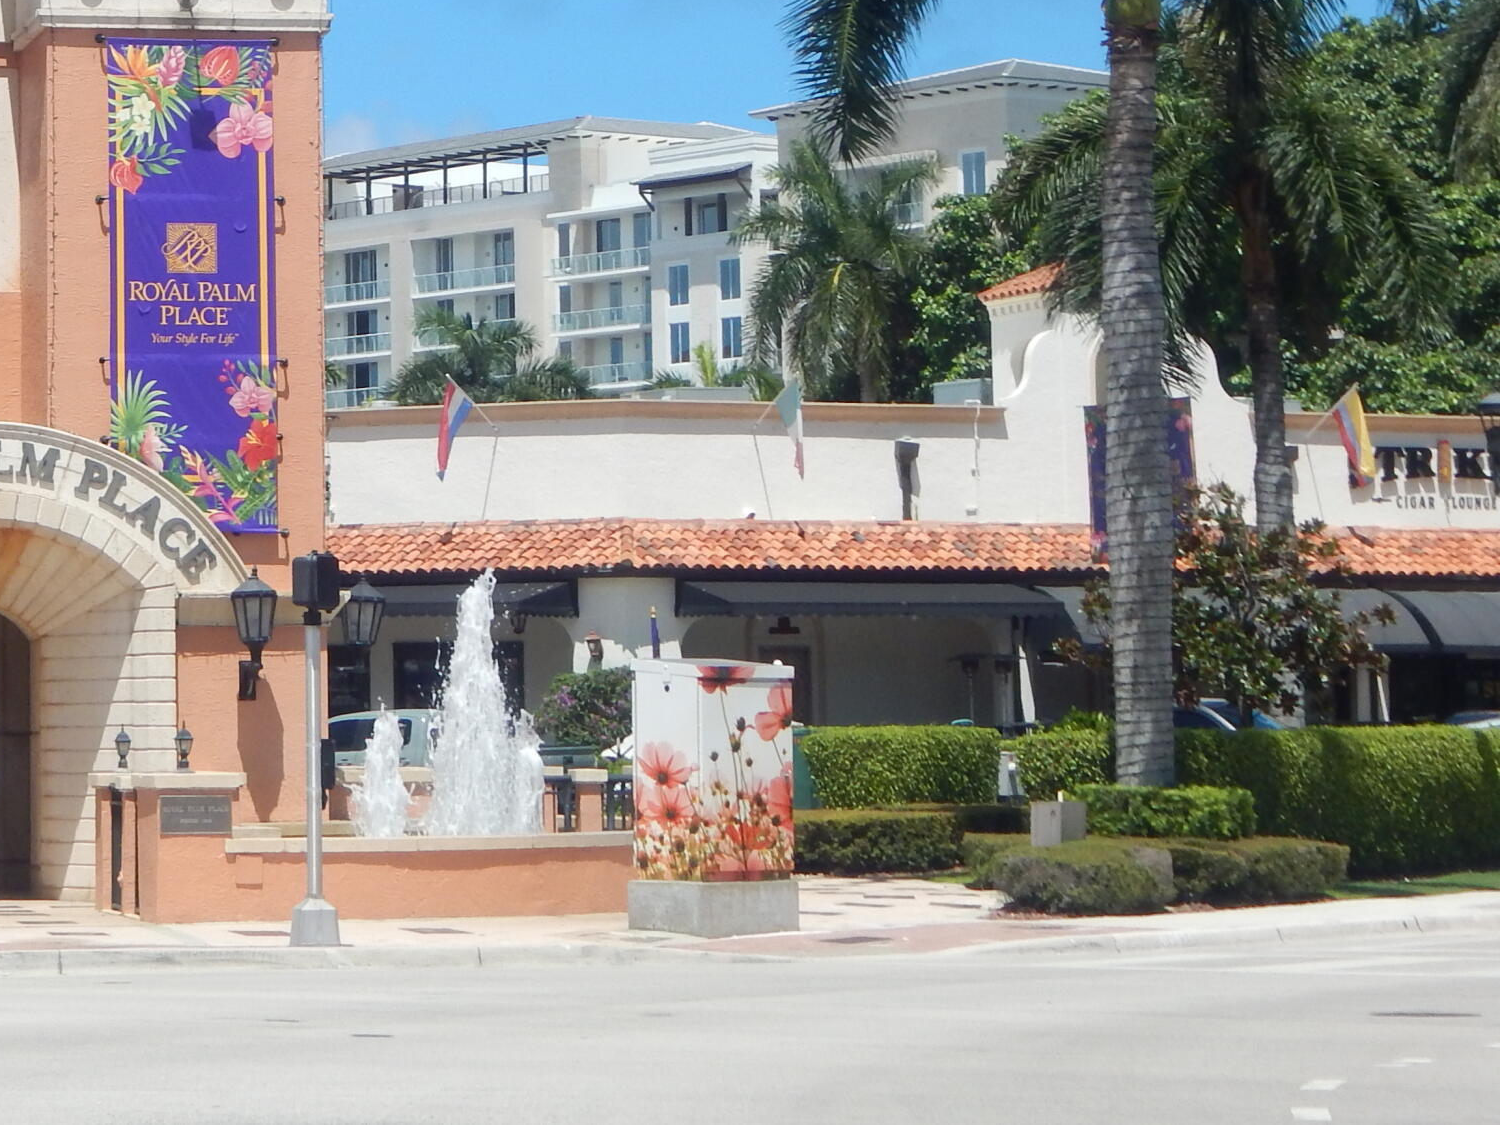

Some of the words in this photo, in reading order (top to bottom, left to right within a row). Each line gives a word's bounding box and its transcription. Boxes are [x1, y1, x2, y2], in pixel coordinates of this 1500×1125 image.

[129, 279, 196, 302] ROYAL
[197, 281, 257, 302] PALM
[150, 332, 174, 344] Your
[175, 332, 199, 347] Style
[200, 332, 215, 344] For
[1349, 440, 1493, 487] TRIK
[1396, 495, 1435, 510] CIGAR
[1451, 496, 1497, 511] LOUNGE
[74, 458, 218, 585] PLACE
